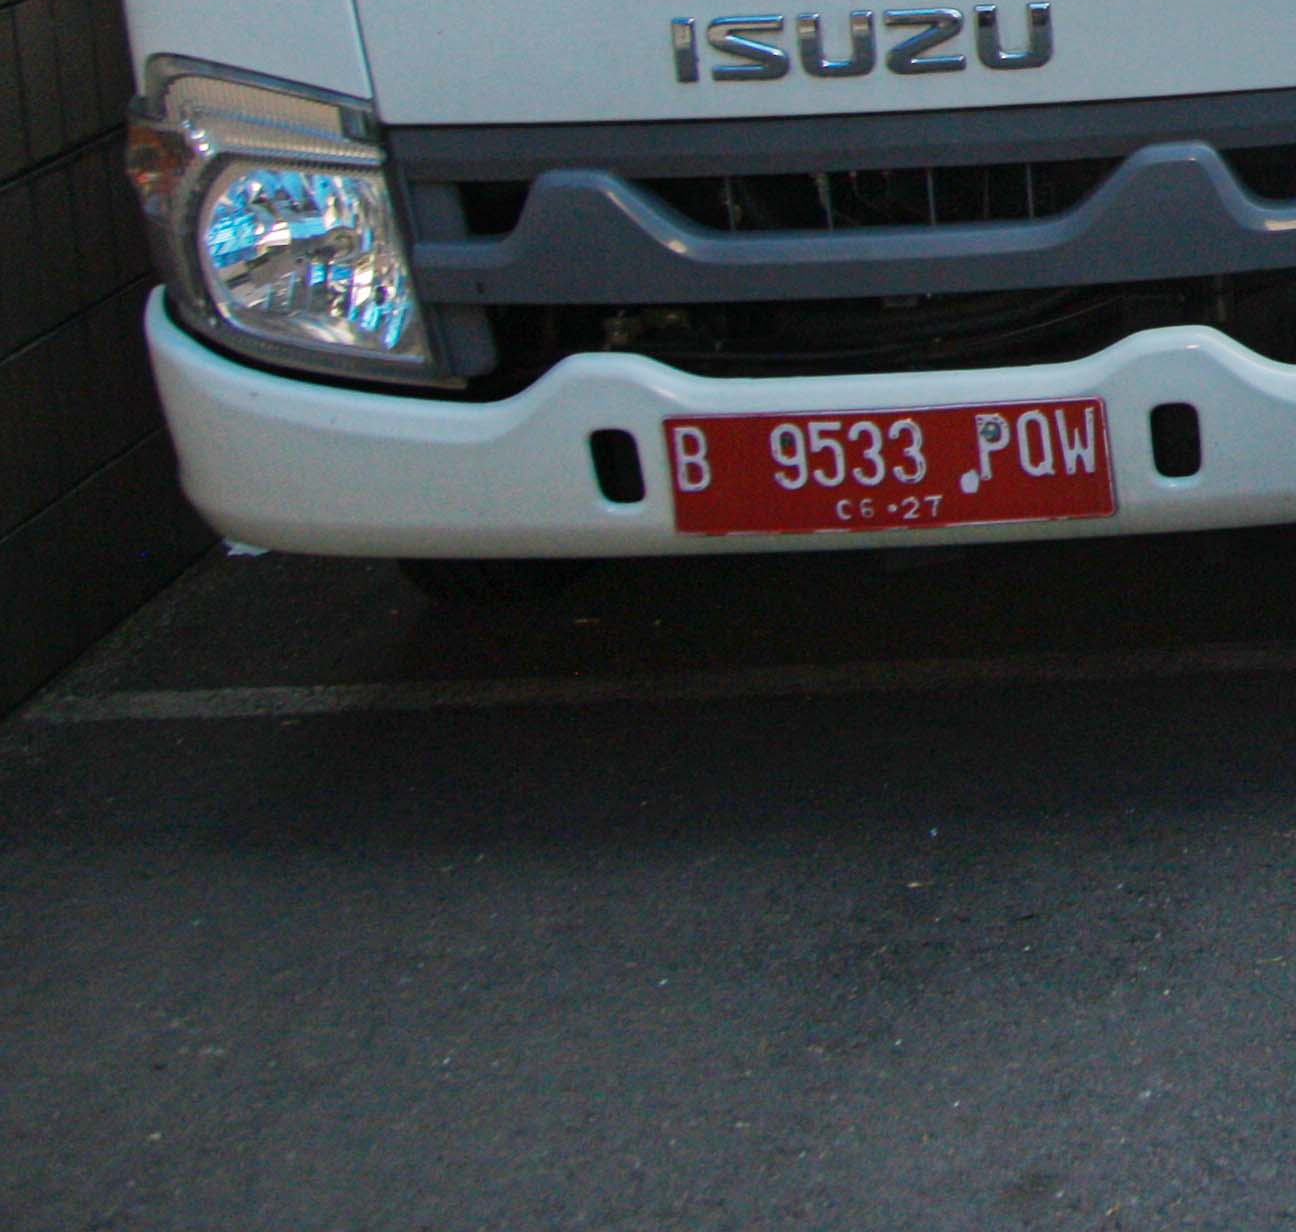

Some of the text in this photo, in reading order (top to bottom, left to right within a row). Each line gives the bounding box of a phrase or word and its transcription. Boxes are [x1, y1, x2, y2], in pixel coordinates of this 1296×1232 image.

[671, 0, 1054, 84] ISUZU
[672, 406, 1098, 492] B 9533 PQW
